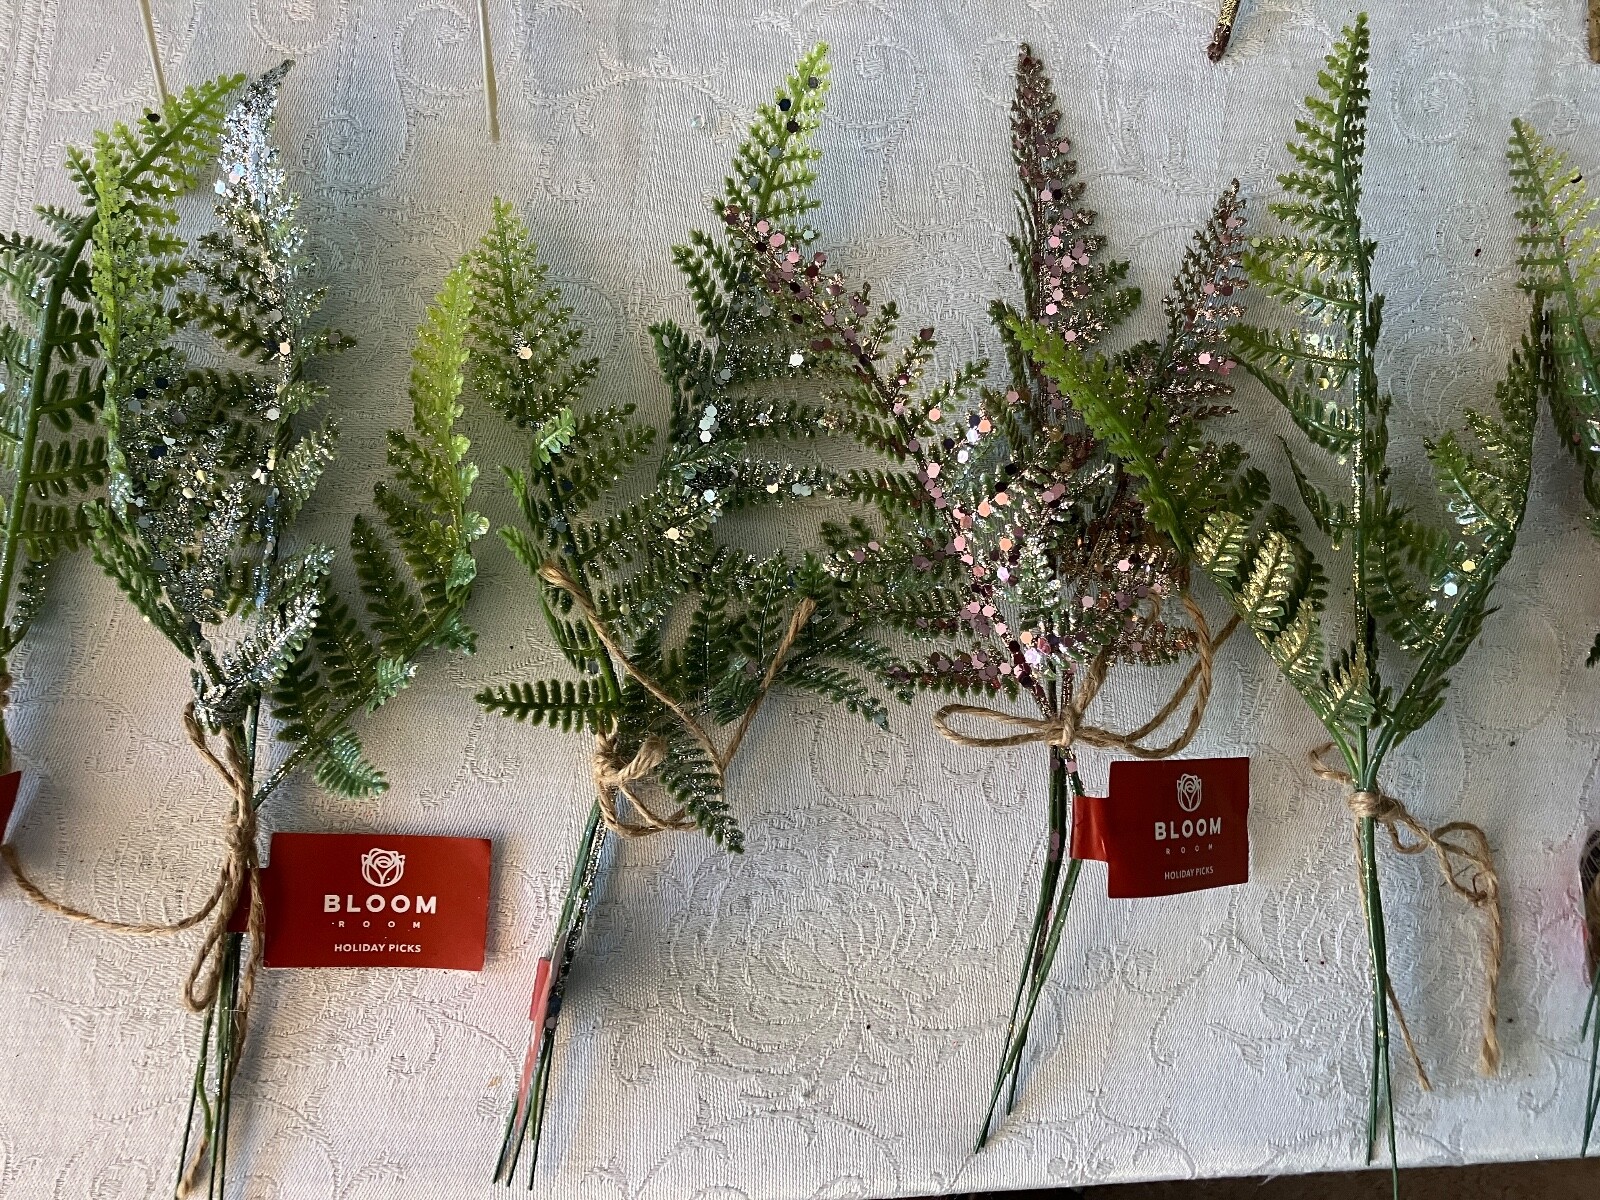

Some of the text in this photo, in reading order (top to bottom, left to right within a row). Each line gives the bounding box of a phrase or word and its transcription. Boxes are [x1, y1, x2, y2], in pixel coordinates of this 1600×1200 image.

[1154, 817, 1222, 841] BLOOM
[1165, 843, 1213, 855] ROOM
[1164, 865, 1214, 881] HOLIDAY PICKS
[323, 894, 437, 914] BLOOM
[338, 920, 421, 929] ROOM
[334, 943, 422, 953] HOLIDAY PICKS
